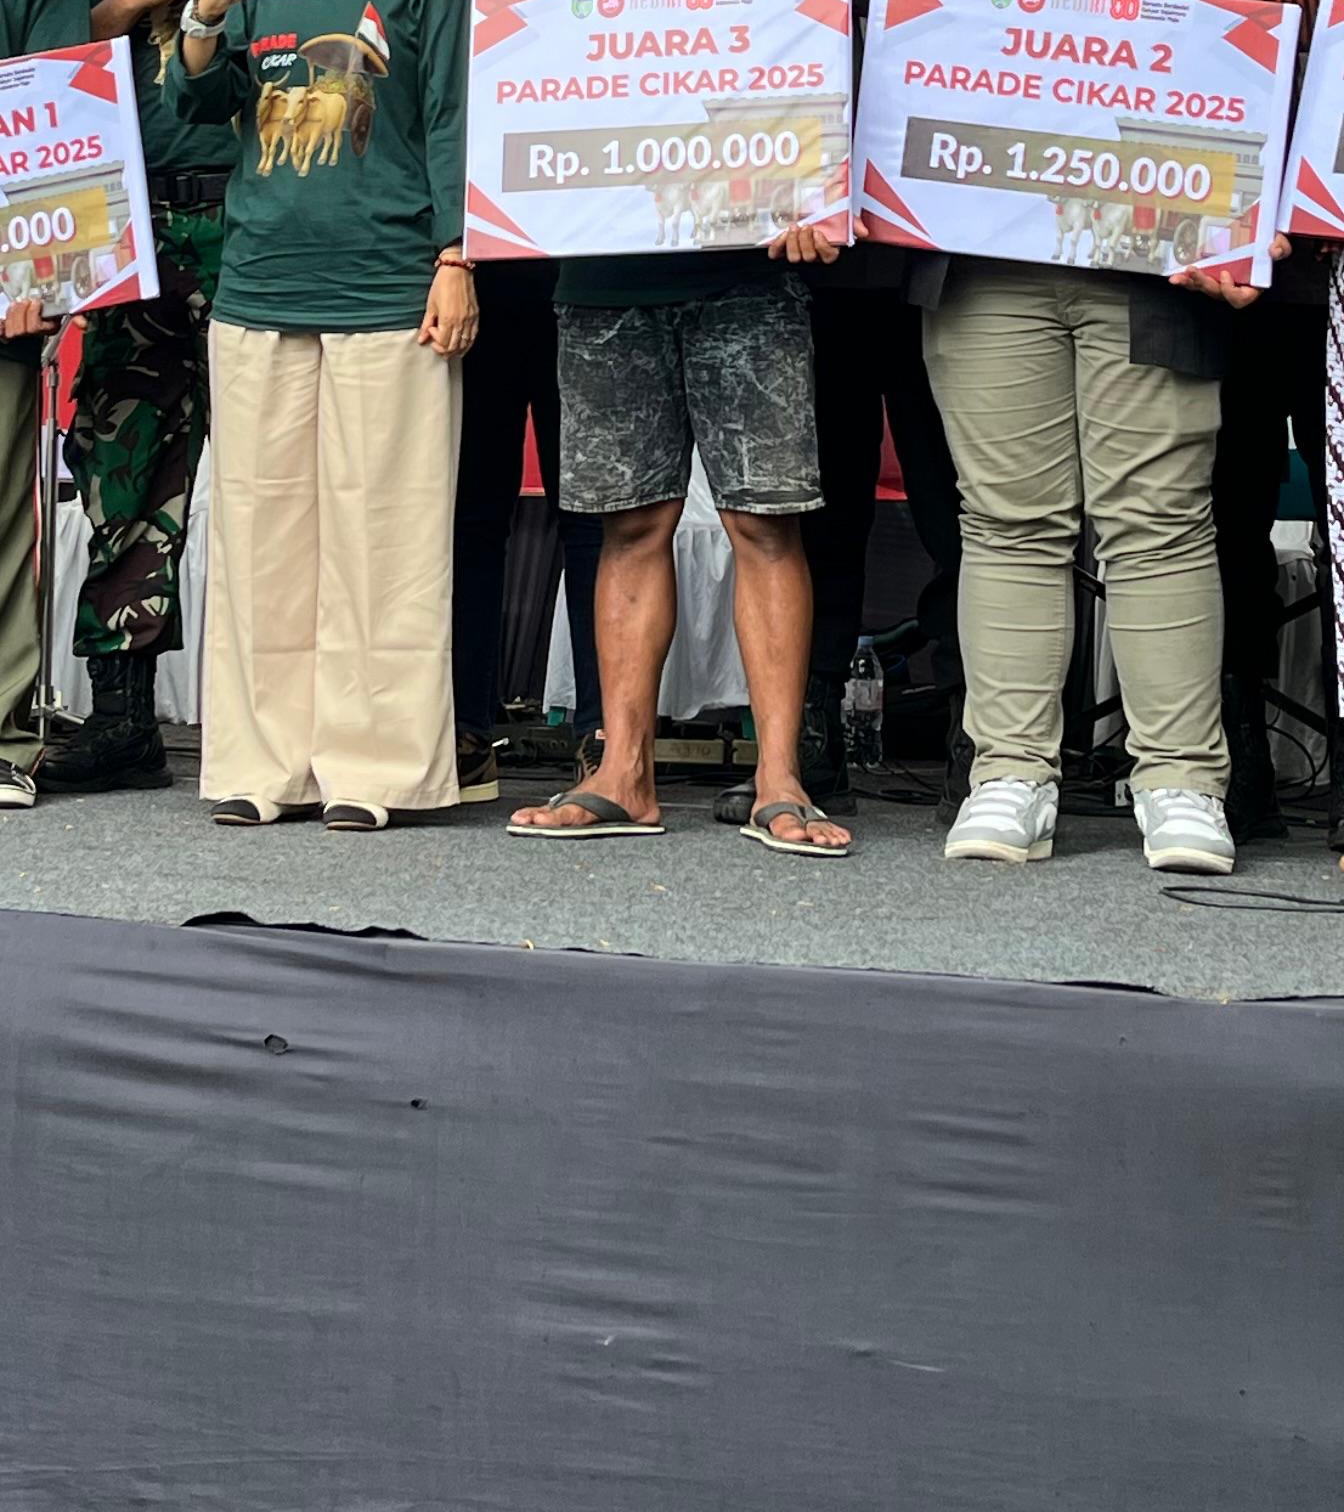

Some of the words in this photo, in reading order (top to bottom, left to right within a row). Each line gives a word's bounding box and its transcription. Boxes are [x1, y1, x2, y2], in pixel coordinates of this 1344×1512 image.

[586, 27, 719, 62] JUARA
[728, 25, 751, 53] 3
[1001, 27, 1138, 71] JUARA
[1149, 43, 1173, 73] 2
[496, 74, 630, 105] PARADE
[639, 68, 741, 97] CIKAR
[747, 63, 825, 91] 2025
[903, 59, 1042, 100] PARADE
[1052, 76, 1156, 114] CIKAR
[1164, 90, 1246, 123] 2025
[44, 101, 58, 129] 1
[37, 134, 103, 169] 2025
[527, 143, 590, 184] Rp.
[602, 130, 800, 175] 1.000.000
[928, 132, 993, 180] Rp.
[1005, 141, 1212, 202] 1.250.000
